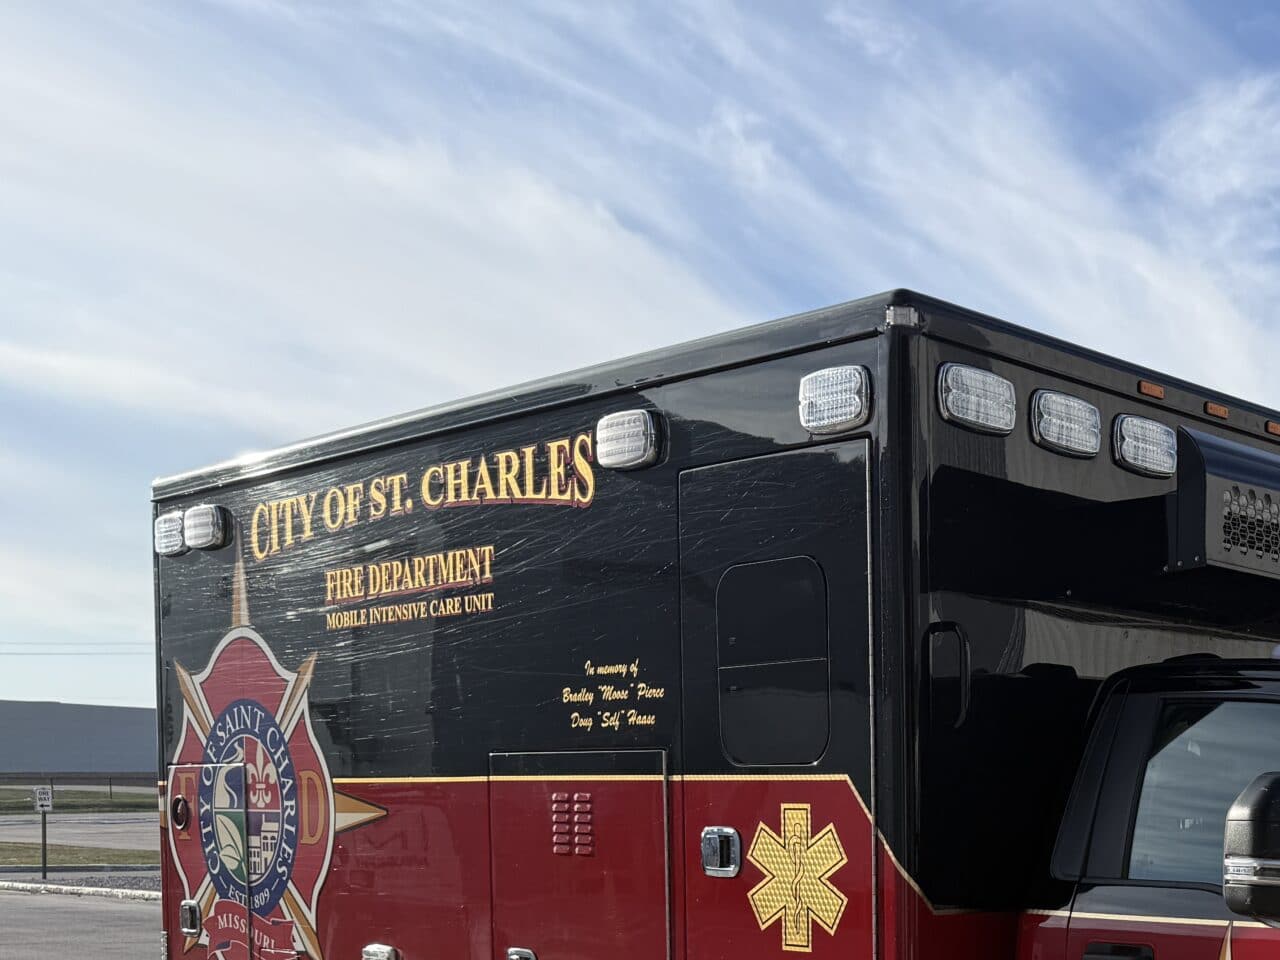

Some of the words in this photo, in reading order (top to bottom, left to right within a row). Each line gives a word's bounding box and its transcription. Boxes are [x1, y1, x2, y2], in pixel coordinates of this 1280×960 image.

[250, 491, 317, 562] CITY
[323, 483, 364, 531] OF
[369, 473, 413, 519] ST.
[421, 431, 595, 509] CHARLES
[325, 566, 365, 605] FIRE
[368, 546, 495, 597] DEPARTMENT
[326, 608, 367, 630] MOBILE
[369, 601, 428, 625] INTENSIVE
[430, 596, 462, 618] CARE
[465, 592, 495, 613] UNIT
[584, 659, 595, 676] In
[597, 664, 628, 678] memory
[629, 658, 639, 678] of
[562, 687, 595, 706] Bradley
[637, 682, 665, 701] Pierce
[216, 705, 265, 746] SAINT
[570, 711, 594, 732] Doug
[627, 708, 656, 726] Haase
[201, 742, 219, 786] OF
[177, 770, 197, 840] F
[299, 769, 326, 845] D
[266, 727, 297, 882] CHARLES
[199, 795, 221, 875] CITY
[250, 888, 270, 910] 1809
[217, 912, 276, 953] MISSURI
